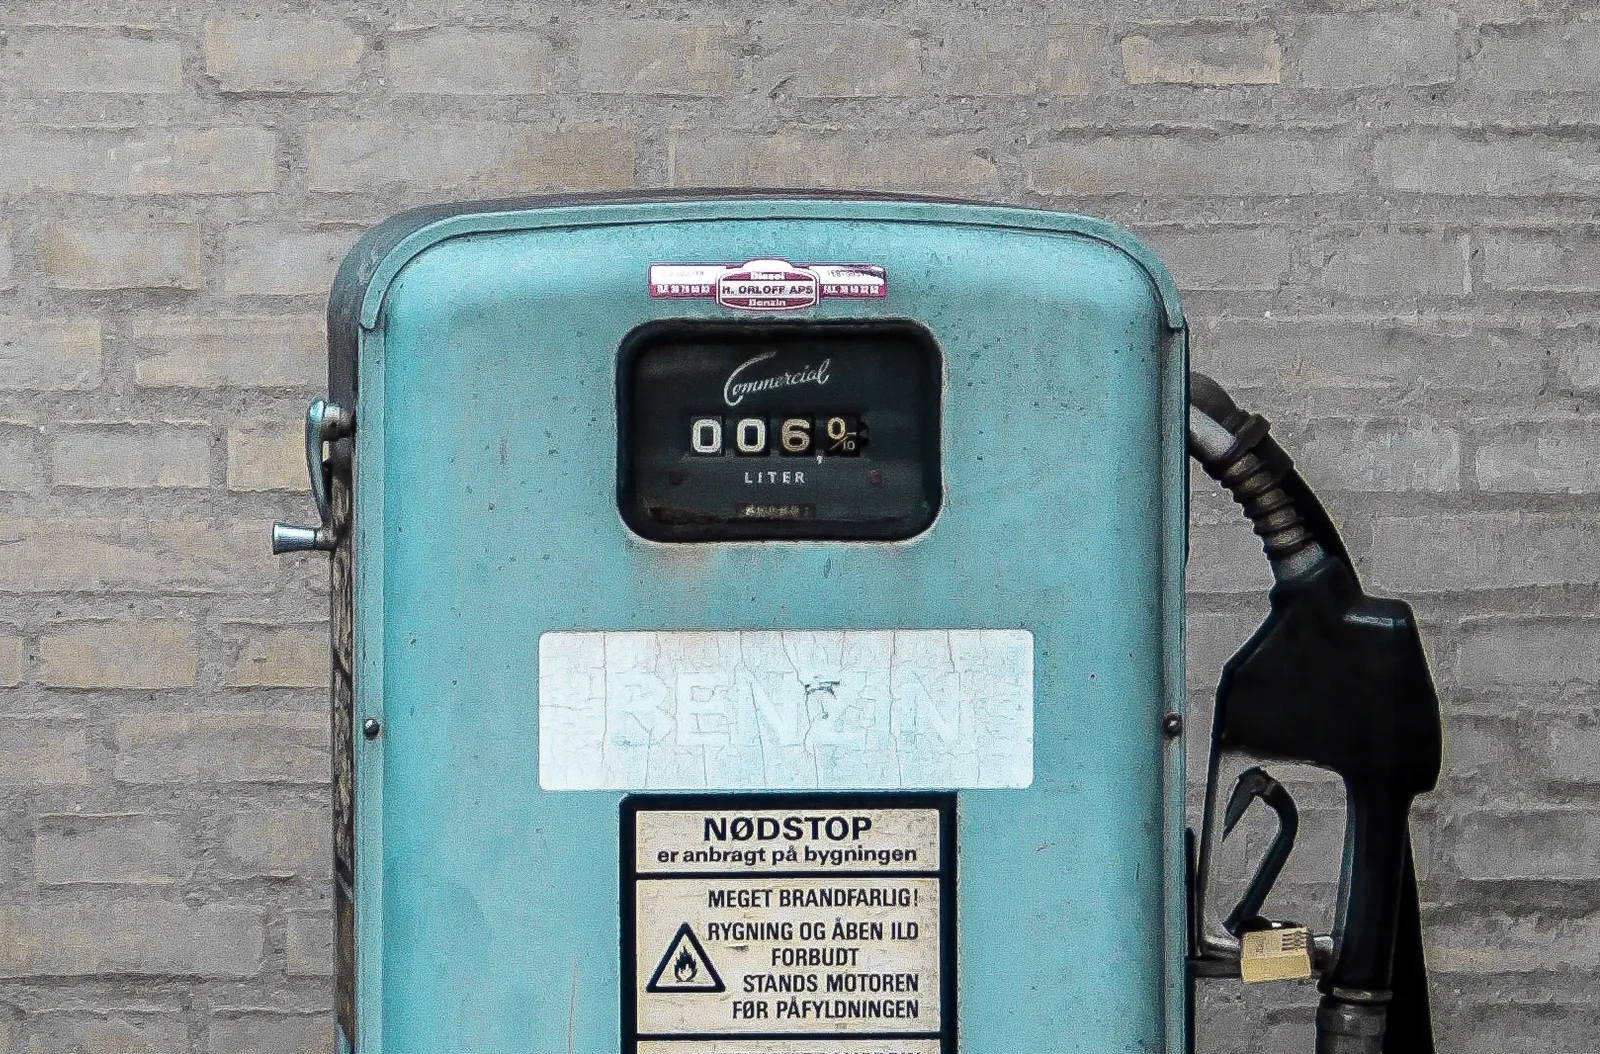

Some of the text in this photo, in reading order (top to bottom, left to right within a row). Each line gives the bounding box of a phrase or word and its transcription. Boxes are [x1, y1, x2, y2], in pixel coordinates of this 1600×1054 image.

[738, 285, 785, 295] ORLOFF
[789, 285, 813, 295] APS
[724, 351, 831, 407] Commercial
[744, 471, 806, 484] LITER
[703, 816, 872, 842] NØDSTOP
[657, 844, 917, 867] er anbragt på bygningen
[708, 887, 918, 908] MEGET BRANDFARLIG!
[707, 918, 919, 941] RYGNING OG ÅBEN ILD
[771, 947, 859, 967] FORBUDT
[743, 973, 919, 993] STANDS MOTOREN
[732, 997, 919, 1020] FØR PÅFYLDNINGEN
